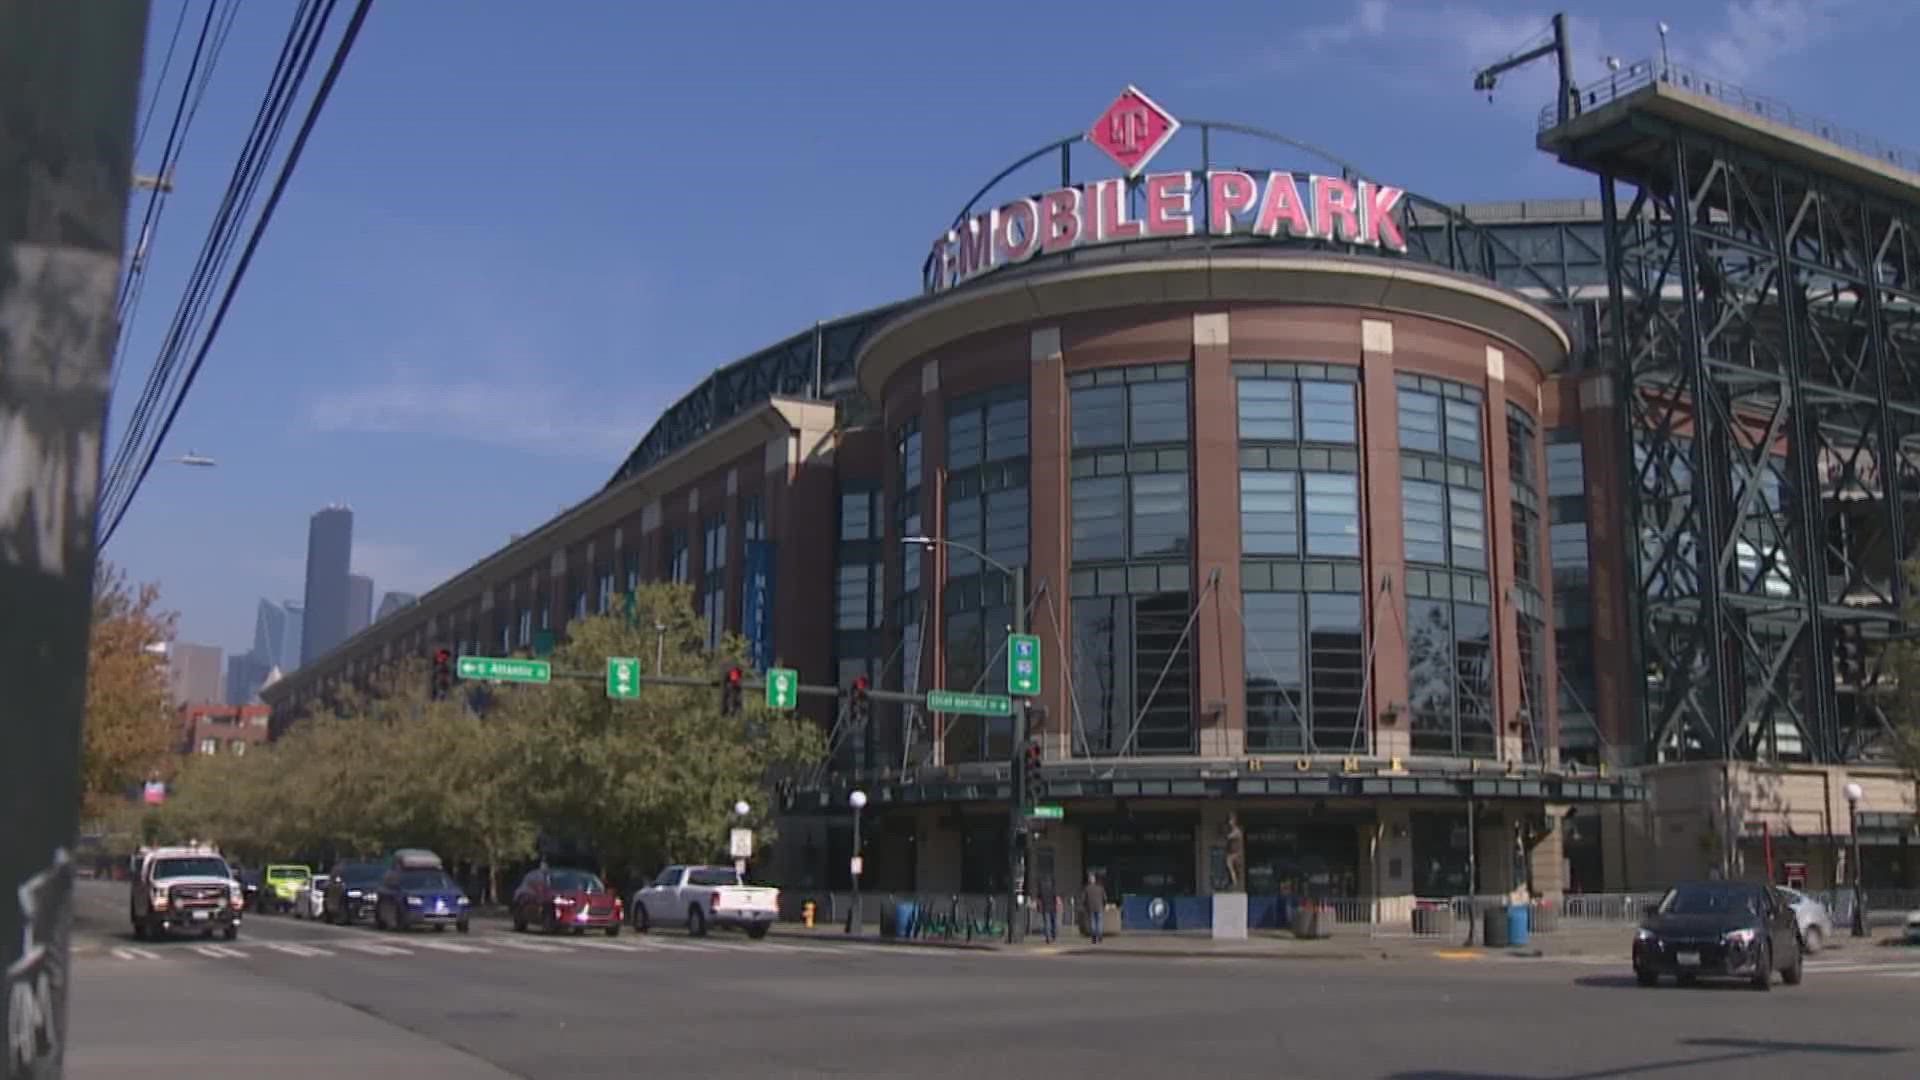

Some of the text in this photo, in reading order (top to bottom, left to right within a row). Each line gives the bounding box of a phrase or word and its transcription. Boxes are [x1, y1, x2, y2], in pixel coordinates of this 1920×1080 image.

[1109, 108, 1149, 154] T
[933, 170, 1408, 290] T-MOBILE PARK
[1248, 757, 1403, 772] HOME
